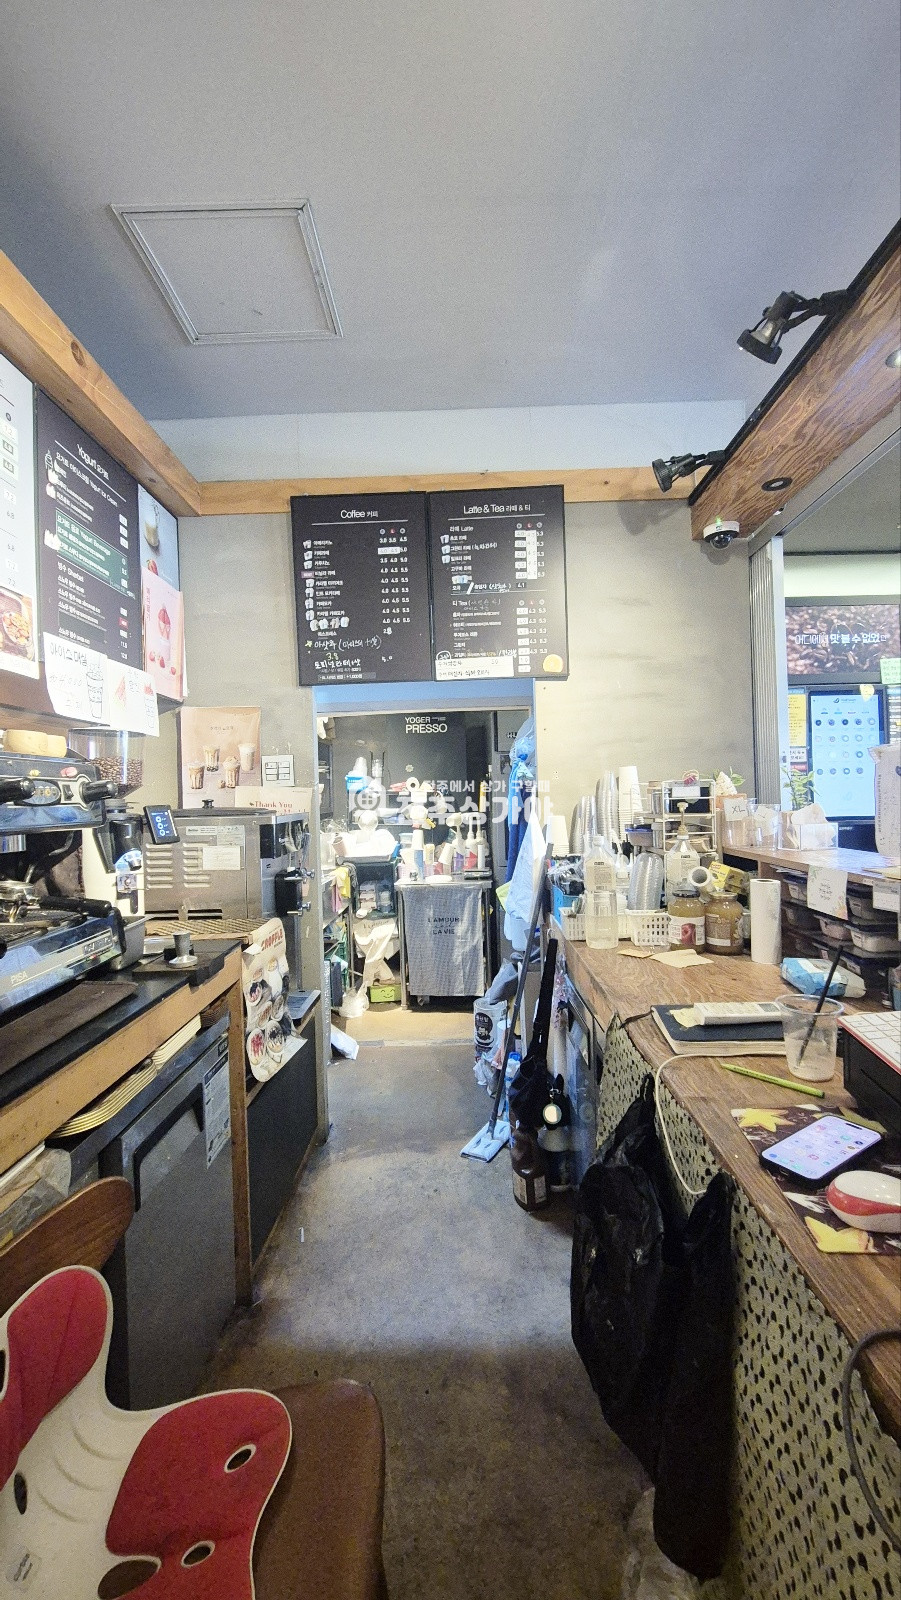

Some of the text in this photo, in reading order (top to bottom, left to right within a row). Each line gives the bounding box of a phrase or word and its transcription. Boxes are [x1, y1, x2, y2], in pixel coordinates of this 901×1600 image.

[77, 444, 97, 470] Yogurt
[340, 509, 379, 519] Coffee 커피
[464, 506, 482, 514] Latte
[483, 505, 490, 513] &
[490, 504, 505, 513] Tea
[852, 634, 861, 644] 수
[405, 724, 448, 734] PRESSO
[731, 806, 746, 814] XL
[10, 970, 28, 984] PISA
